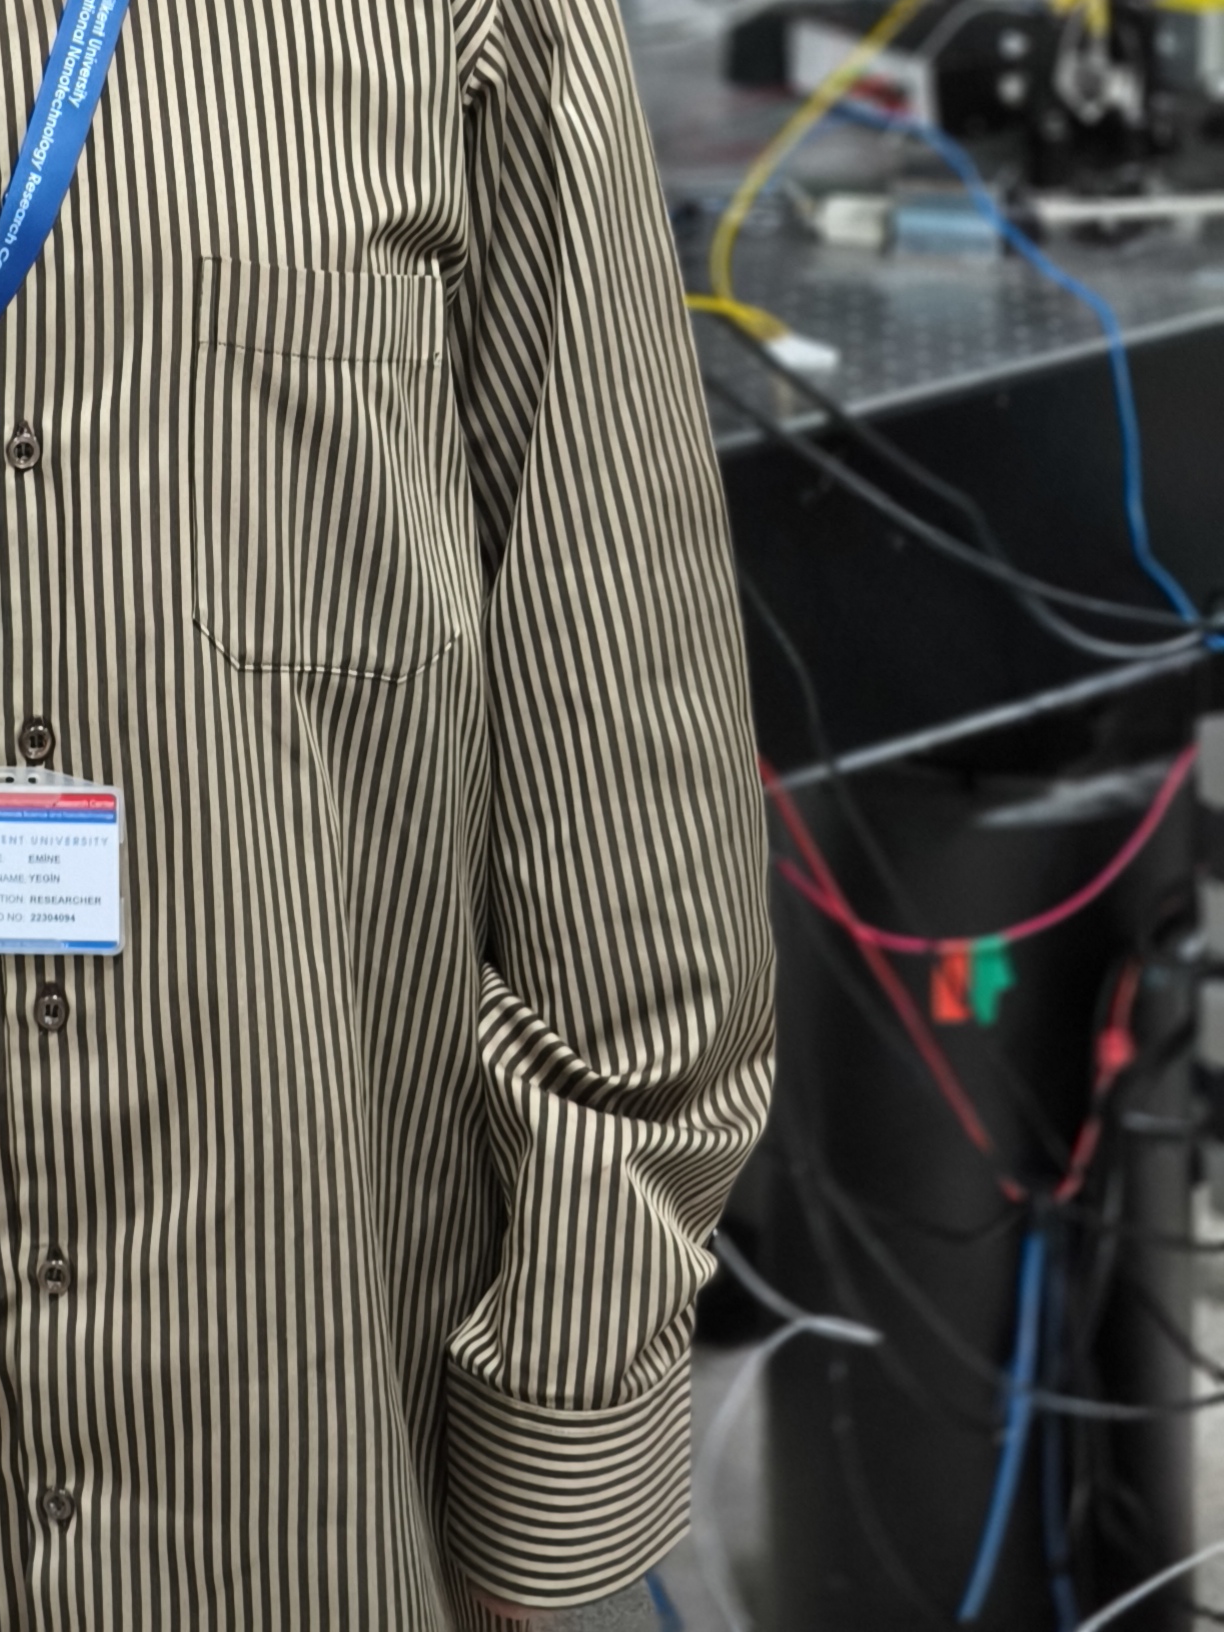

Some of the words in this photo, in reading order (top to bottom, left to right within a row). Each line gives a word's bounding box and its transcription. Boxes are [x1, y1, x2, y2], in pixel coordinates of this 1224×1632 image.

[68, 38, 102, 108] University
[31, 45, 83, 171] Nanotechnology
[4, 171, 42, 245] Research
[30, 835, 109, 846] UNIVERSITY
[29, 895, 102, 906] RESEARCHER
[30, 913, 76, 923] 22304094
